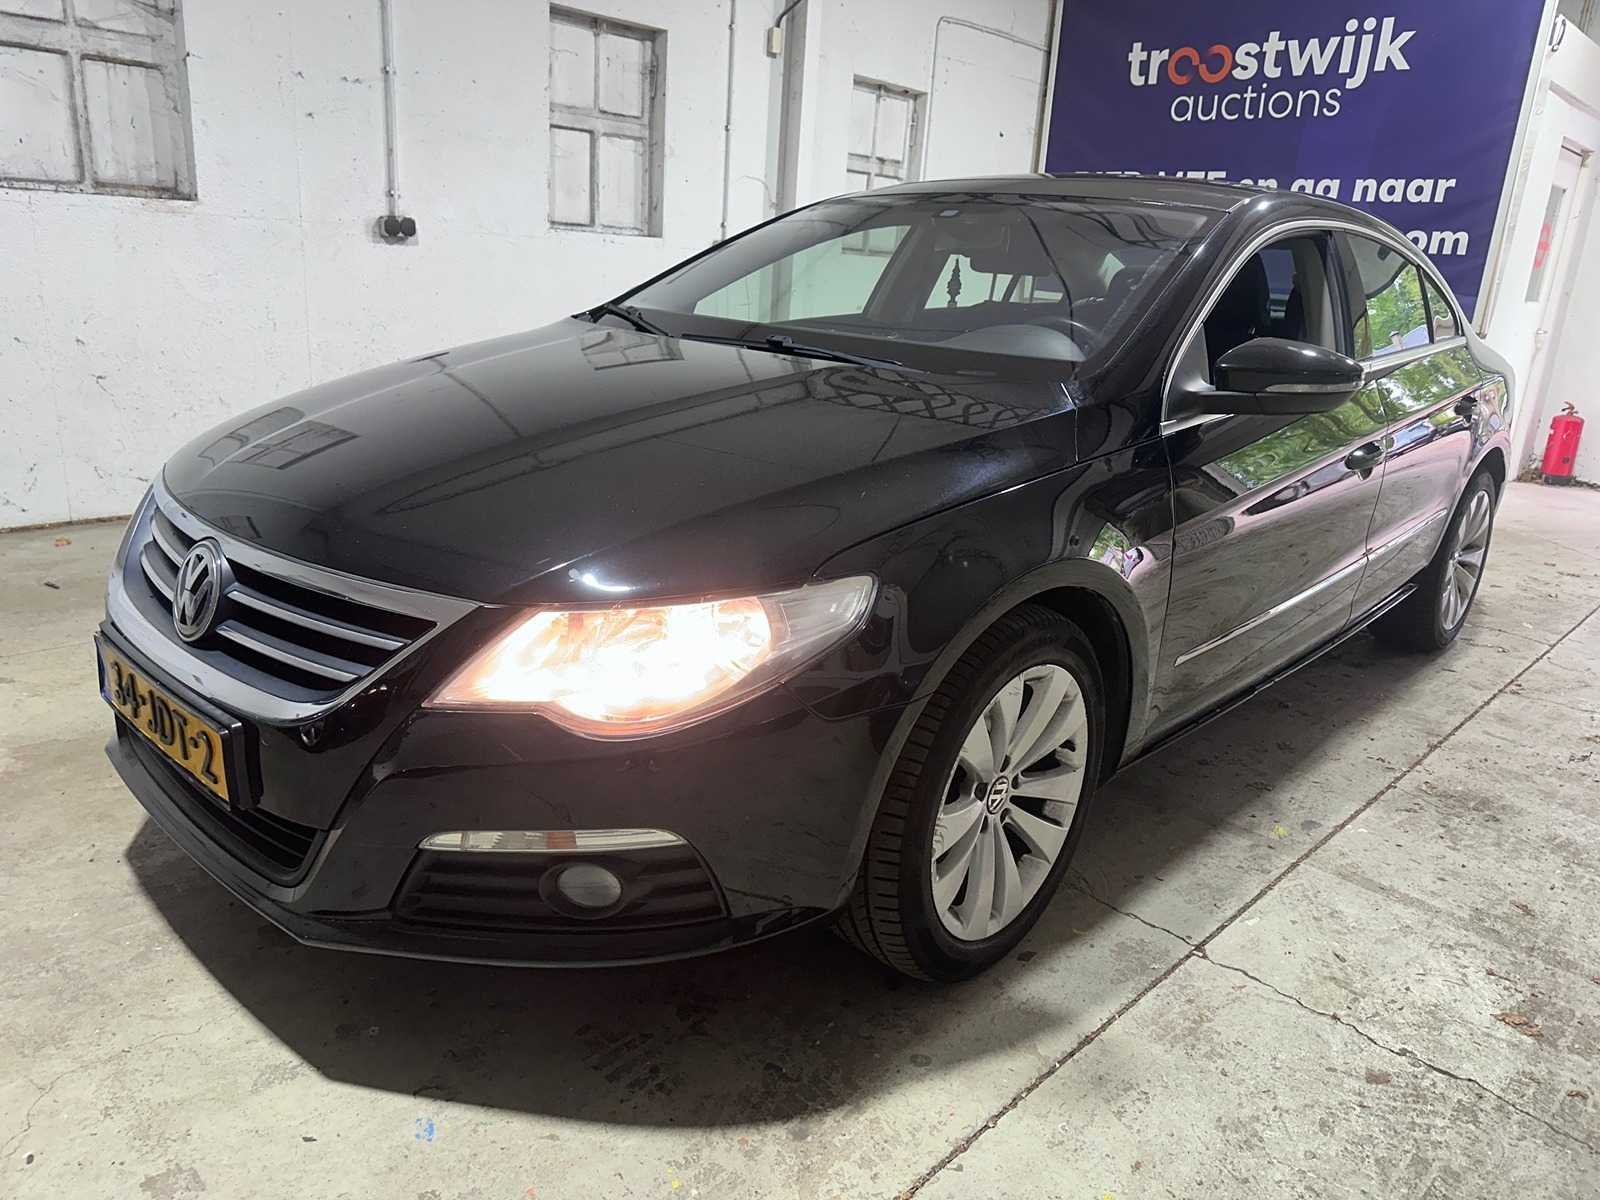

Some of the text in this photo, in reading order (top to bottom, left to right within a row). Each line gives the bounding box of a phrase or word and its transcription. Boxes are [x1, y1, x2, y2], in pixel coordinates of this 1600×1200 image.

[1128, 16, 1417, 89] troostwijk
[1170, 83, 1342, 122] auctions
[1351, 178, 1457, 203] naar
